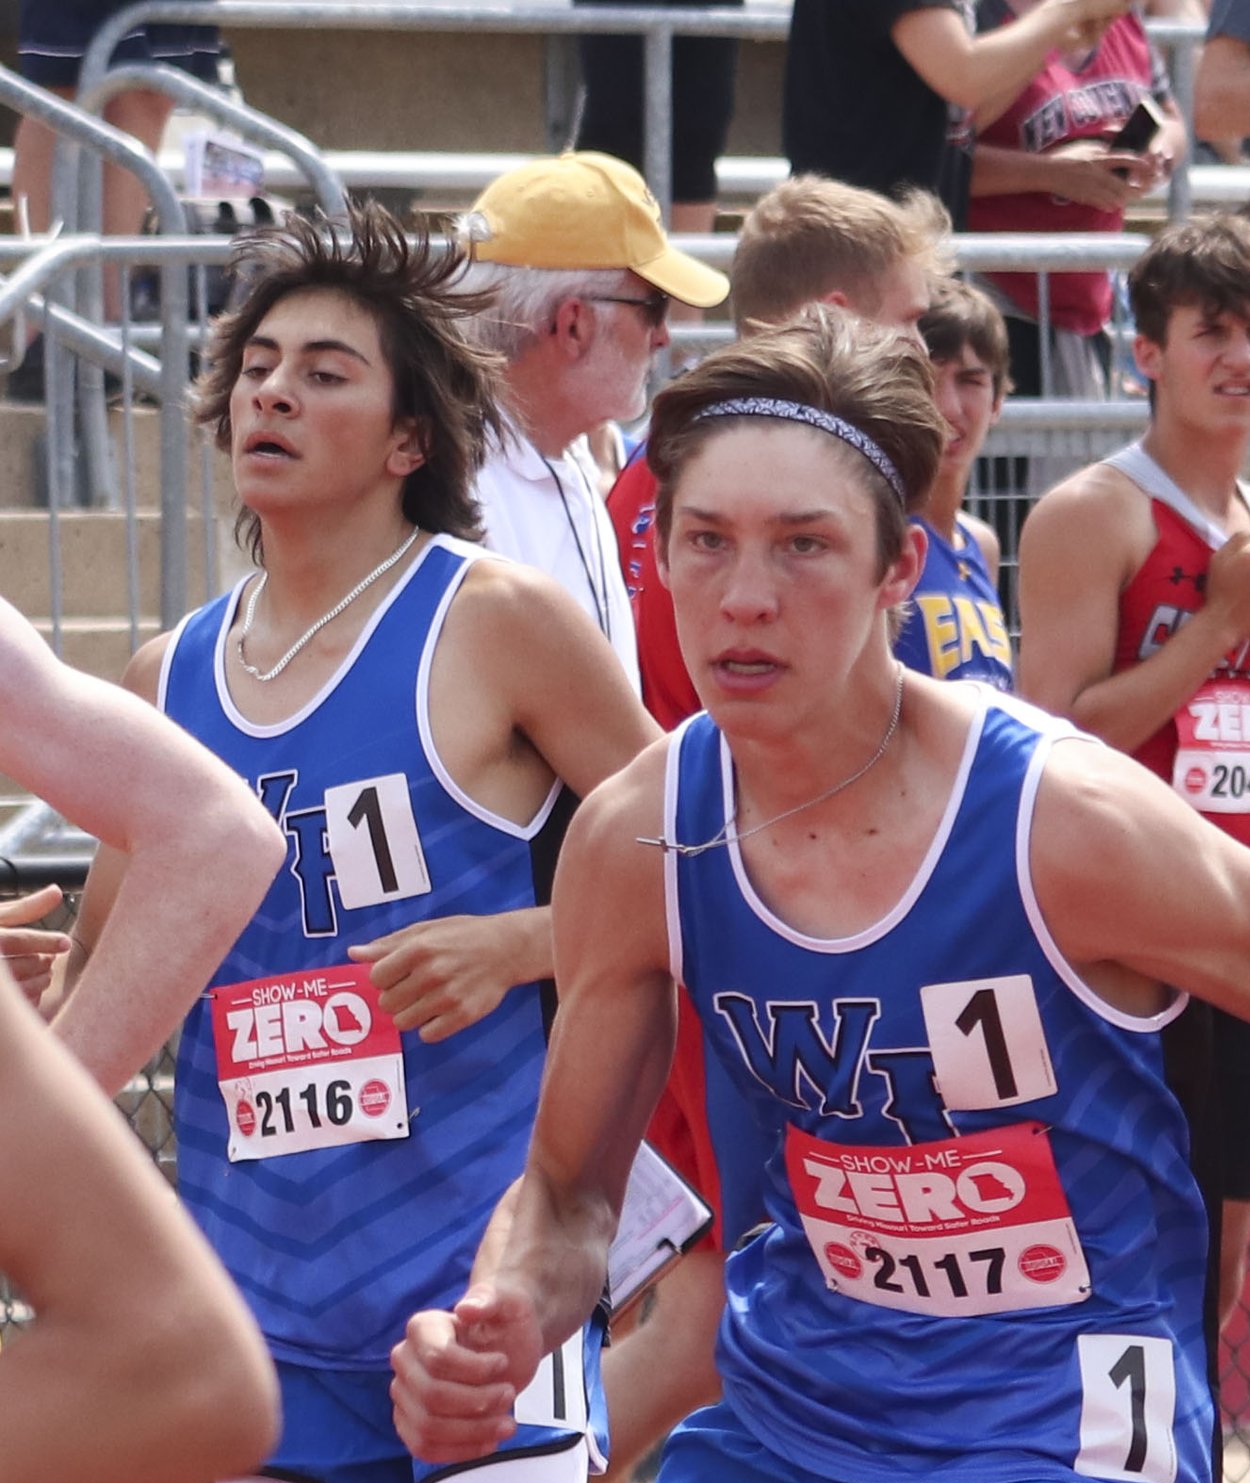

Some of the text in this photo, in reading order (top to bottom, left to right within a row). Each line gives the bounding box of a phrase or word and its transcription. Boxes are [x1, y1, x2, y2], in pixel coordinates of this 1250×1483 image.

[347, 786, 399, 894] 1
[252, 977, 329, 1007] SHOW-ME
[226, 991, 373, 1064] ZERO
[954, 988, 1019, 1100] 1
[255, 1079, 354, 1138] 2116
[802, 1157, 1027, 1224] ZERO
[840, 1149, 962, 1174] SHOW-ME
[864, 1247, 1007, 1299] 2117
[1108, 1344, 1149, 1473] 1
